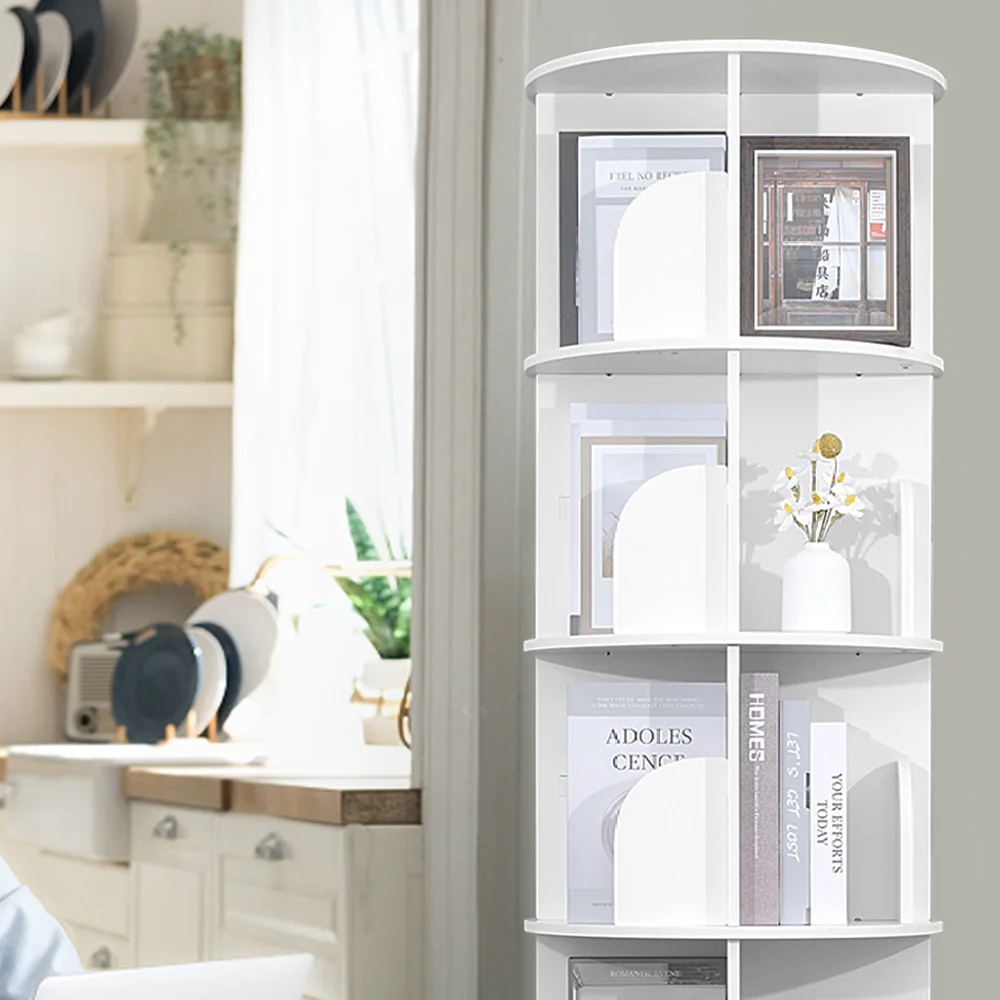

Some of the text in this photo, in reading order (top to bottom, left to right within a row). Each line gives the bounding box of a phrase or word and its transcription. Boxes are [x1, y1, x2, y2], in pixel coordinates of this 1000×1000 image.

[637, 171, 653, 180] NO
[606, 728, 692, 744] ADOLES
[749, 693, 765, 763] HOMES
[786, 790, 802, 818] GET
[817, 800, 828, 846] TODAY
[832, 773, 843, 874] YOUR EFFORTS
[786, 825, 800, 862] LOST
